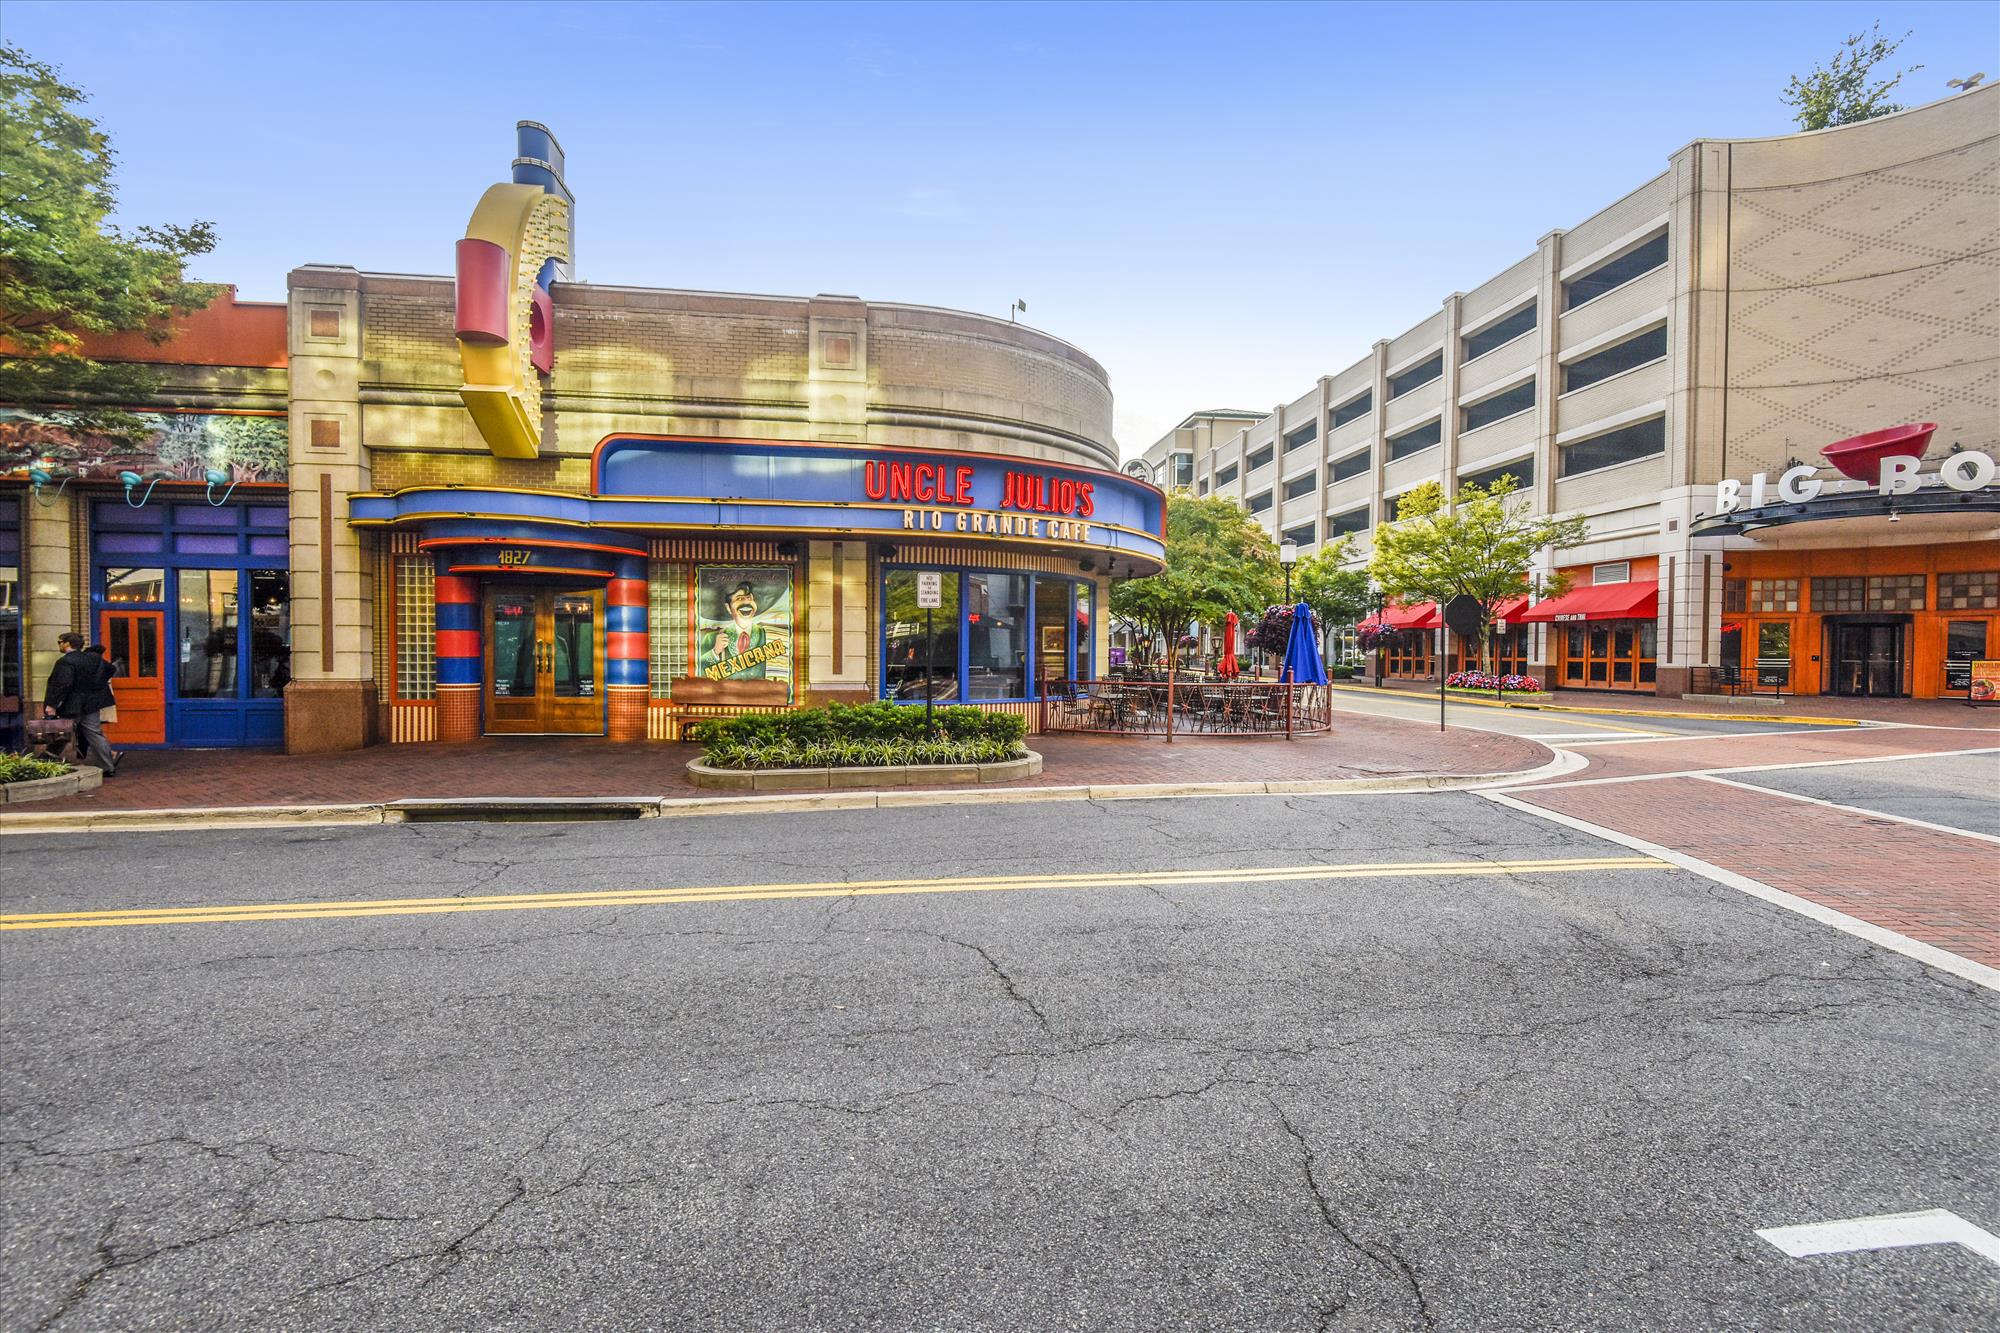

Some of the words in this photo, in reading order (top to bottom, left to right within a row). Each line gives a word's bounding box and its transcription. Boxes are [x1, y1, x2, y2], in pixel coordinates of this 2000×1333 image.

[865, 460, 974, 505] UNCLE
[1000, 471, 1095, 517] JULIO'S
[1715, 464, 1823, 515] BIG
[903, 510, 942, 530] RIO
[955, 512, 1040, 537] GRANDE
[1048, 520, 1091, 542] CAFE
[498, 550, 531, 565] 1827
[704, 638, 787, 681] MEXICANA
